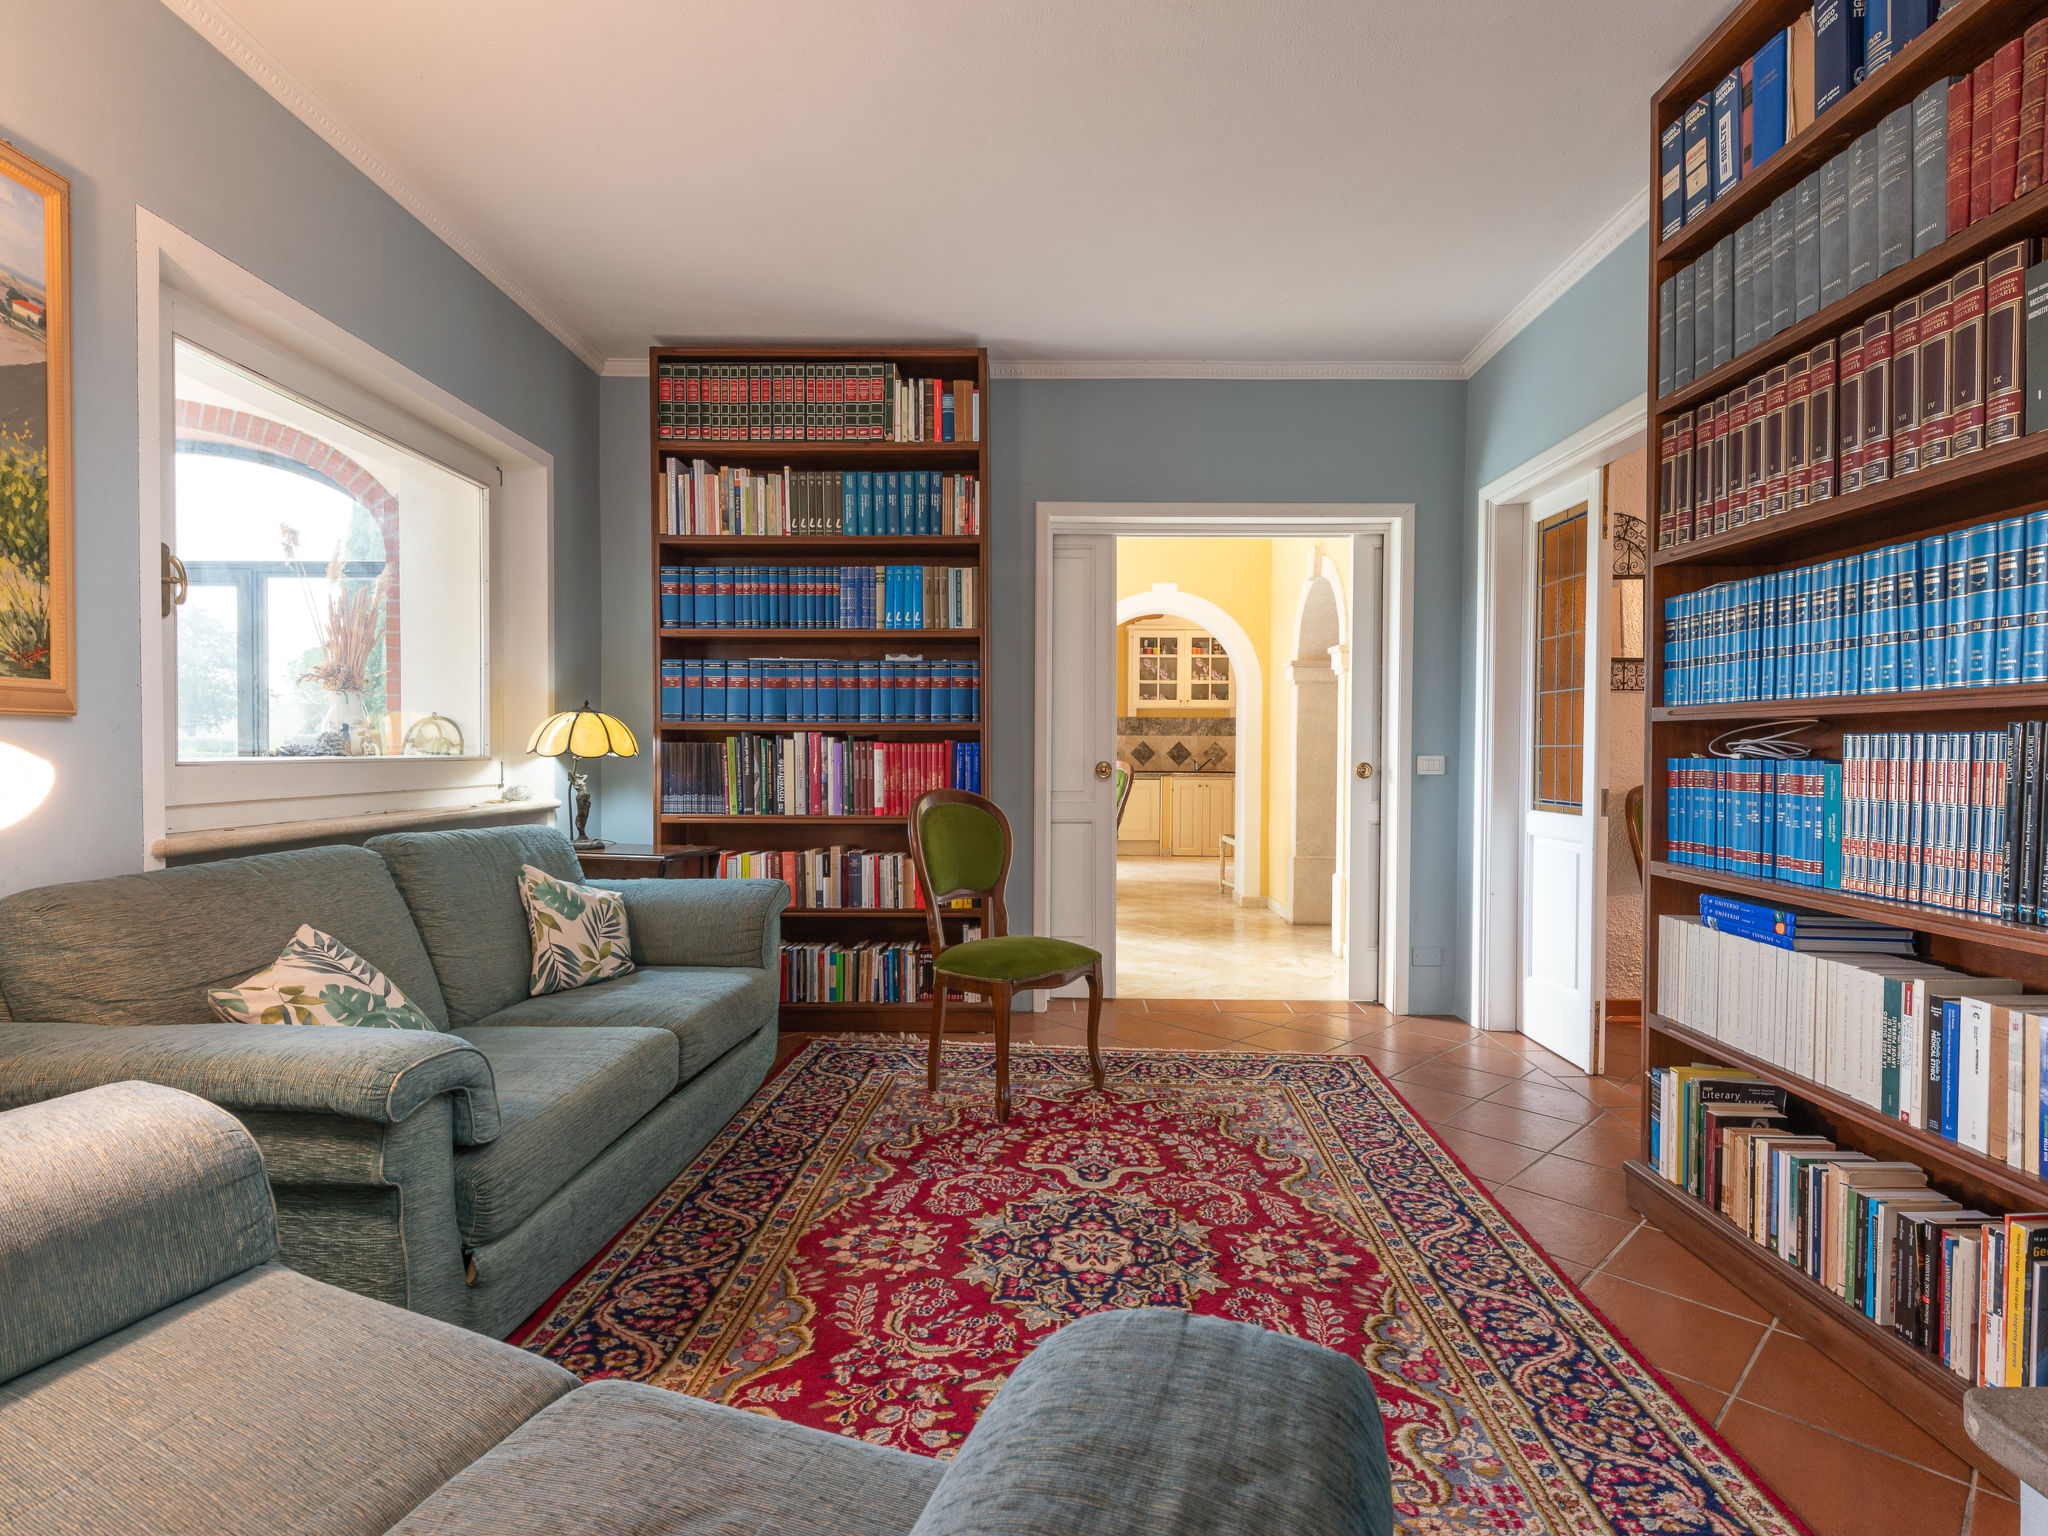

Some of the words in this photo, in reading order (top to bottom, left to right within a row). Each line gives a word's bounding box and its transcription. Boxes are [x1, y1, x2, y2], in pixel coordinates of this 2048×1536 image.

[2026, 735, 2035, 780] CAPOLAVORI
[777, 759, 785, 802] novedrate
[2004, 863, 2010, 878] XX
[1714, 899, 1740, 910] UNIVERSO
[1714, 910, 1740, 921] UNIVERSO
[1702, 1091, 1740, 1101] Literary
